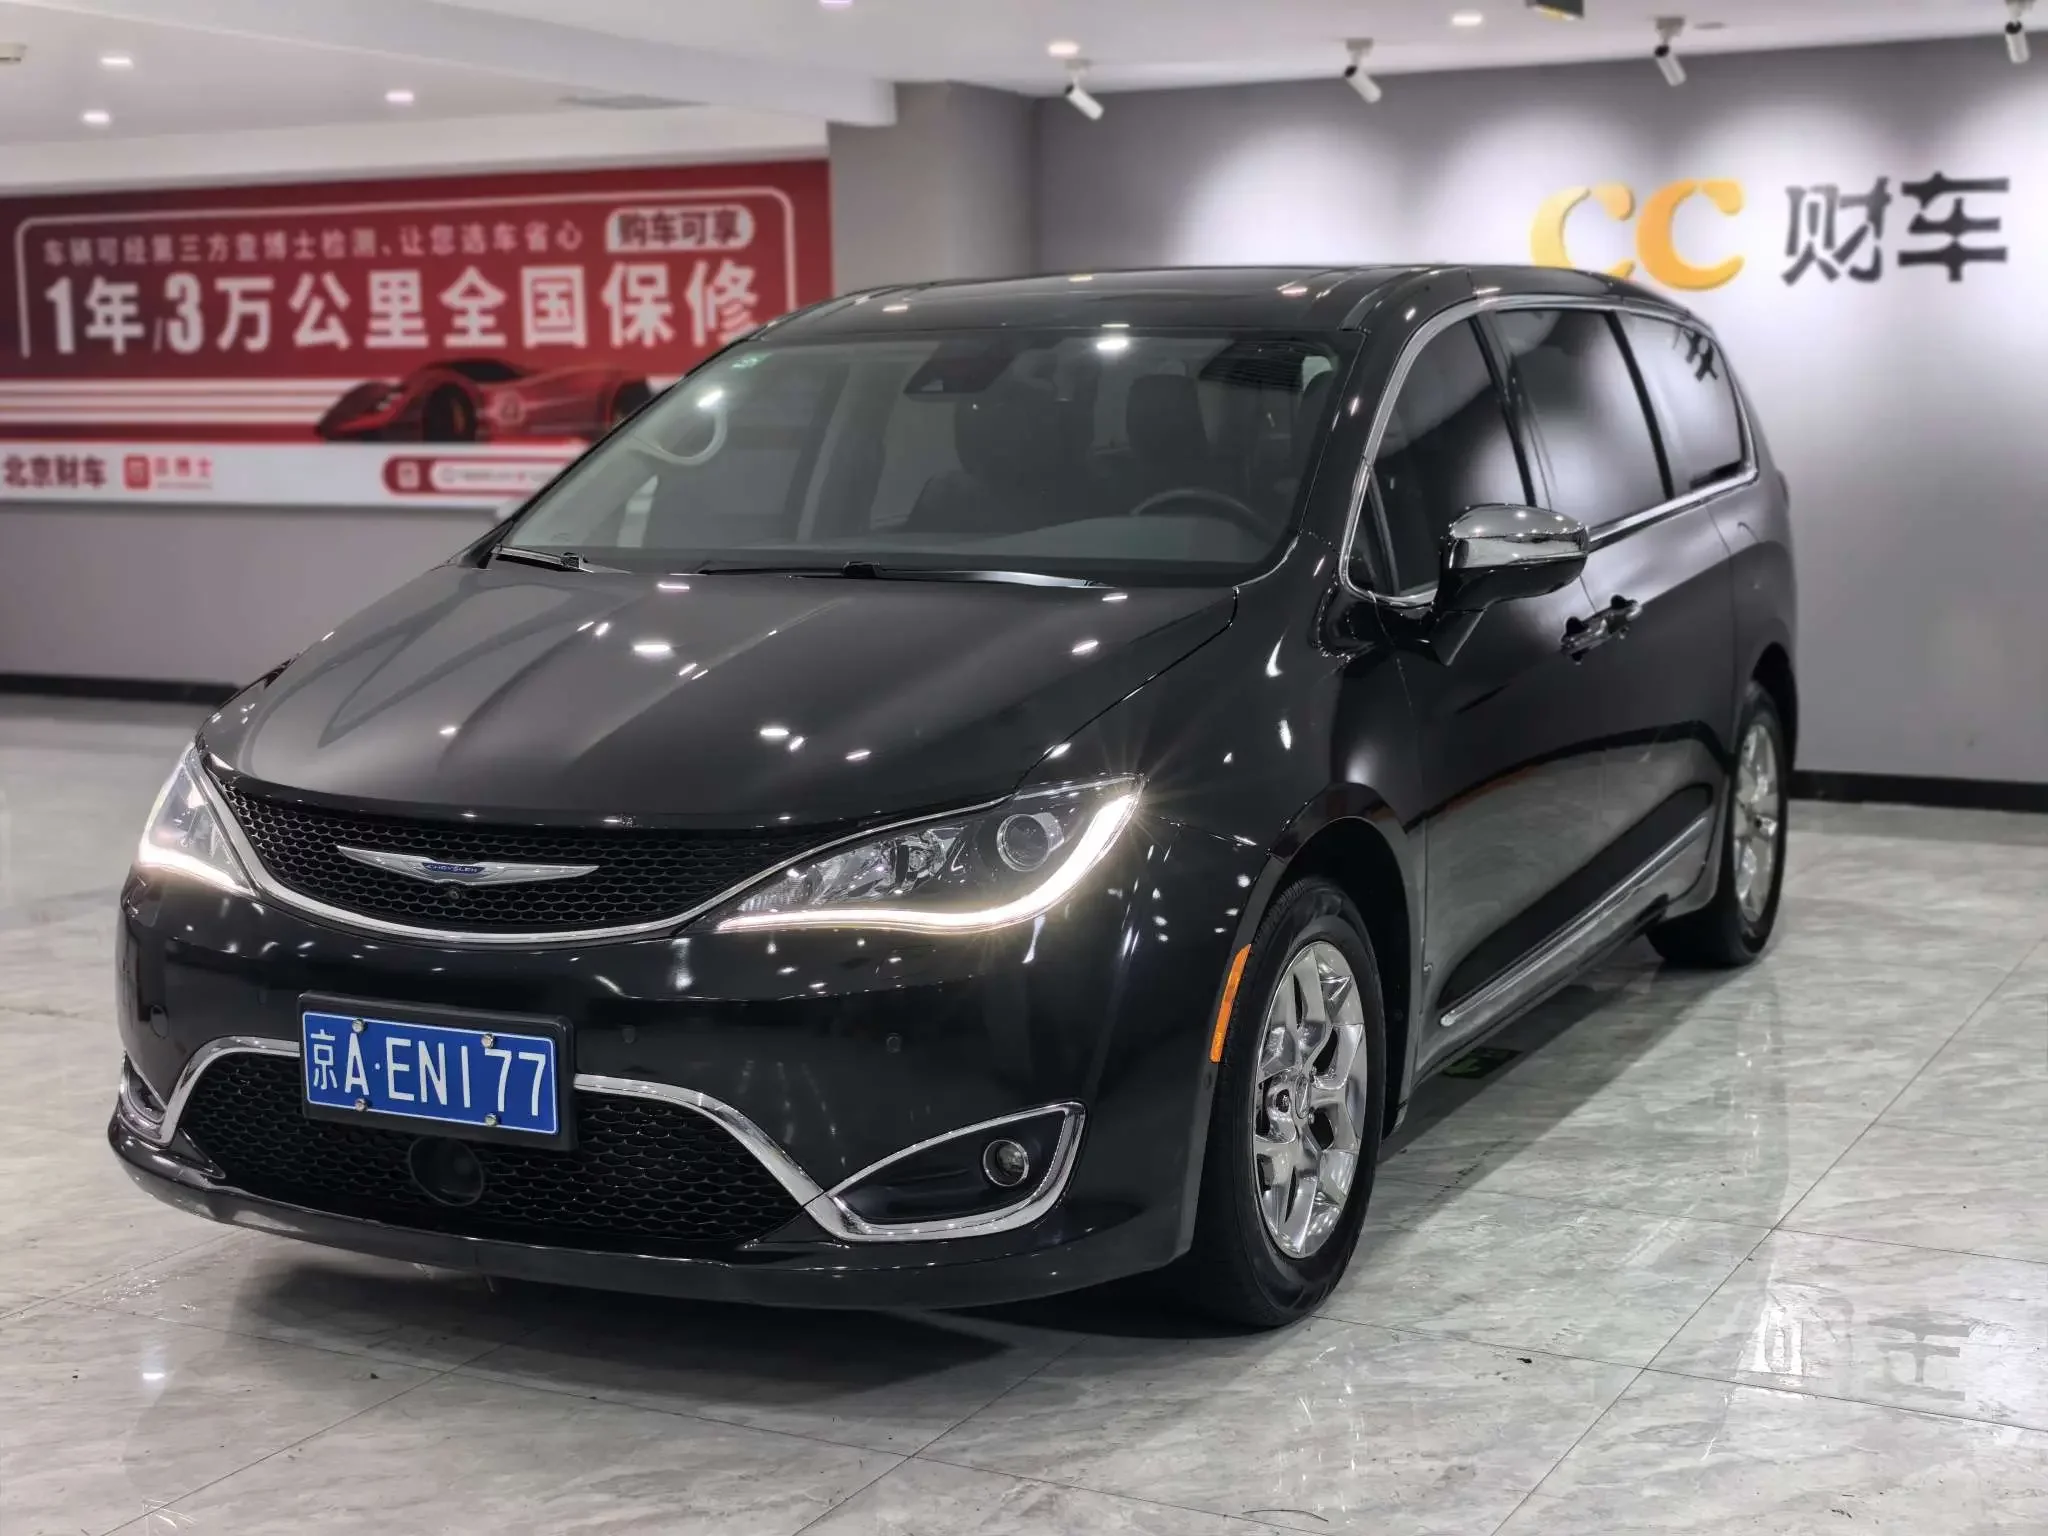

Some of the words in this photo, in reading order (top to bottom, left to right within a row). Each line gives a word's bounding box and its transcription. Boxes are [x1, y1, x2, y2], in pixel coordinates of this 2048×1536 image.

[617, 208, 741, 246] 购车可享
[1530, 178, 1746, 291] CC
[1782, 171, 2010, 286] 财车
[3, 453, 107, 488] 北京财车
[426, 863, 478, 873] CHRYSLER
